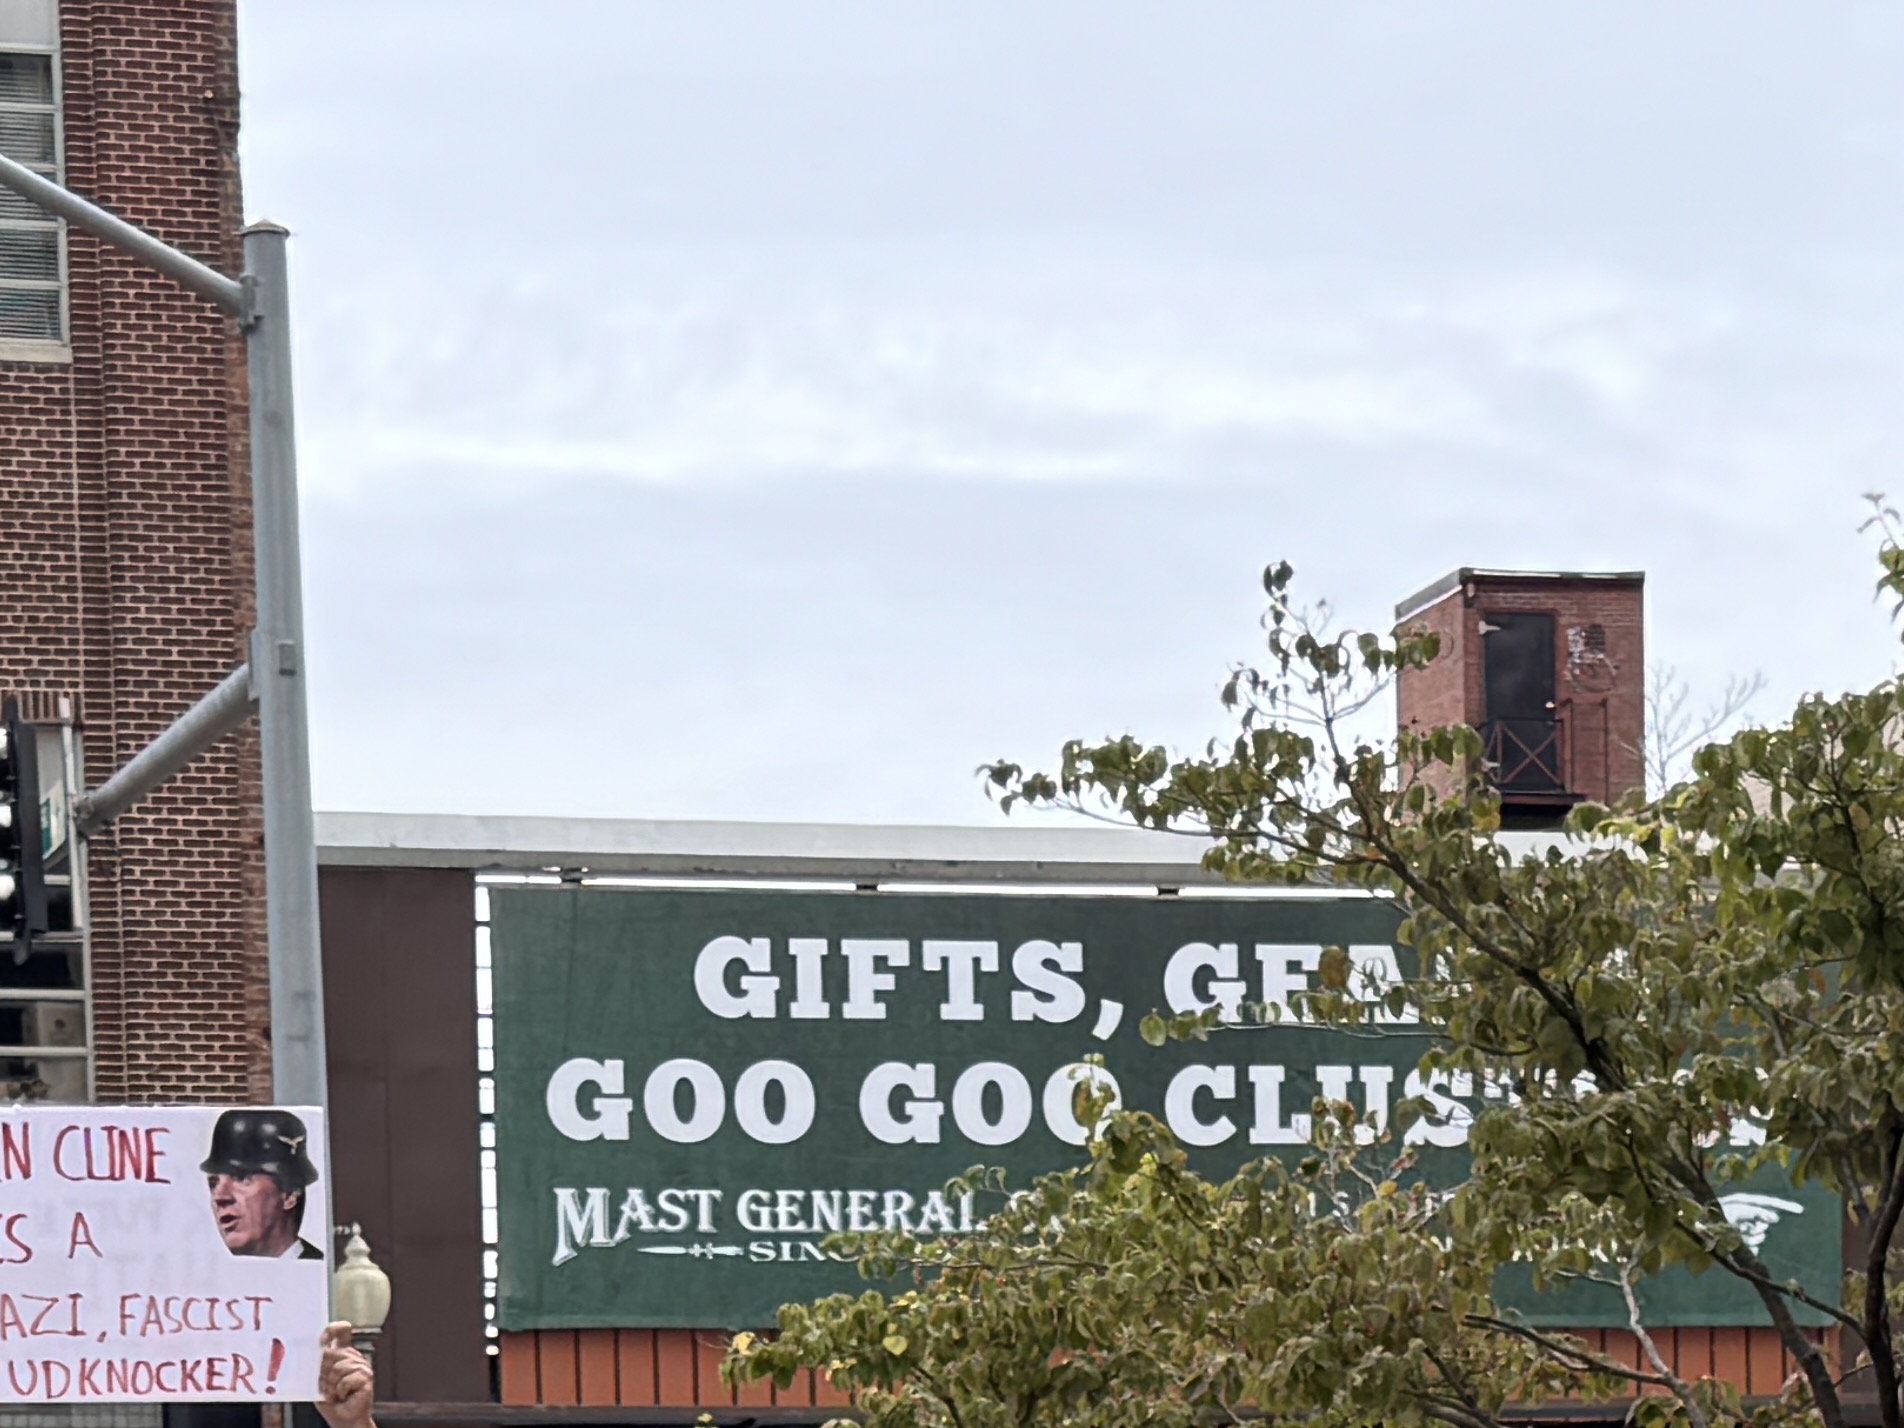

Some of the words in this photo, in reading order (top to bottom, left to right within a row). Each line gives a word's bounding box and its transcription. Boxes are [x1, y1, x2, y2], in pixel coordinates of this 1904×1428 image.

[694, 935, 1124, 1040] GIFTS,
[1163, 942, 1471, 1026] GEA
[545, 1056, 816, 1144] GOO
[859, 1060, 1122, 1146] GOO
[52, 1123, 171, 1185] CLINE
[68, 1211, 103, 1260] A
[552, 1186, 724, 1267] MAST
[748, 1240, 859, 1262] SIN
[118, 1293, 274, 1337] FASCIST
